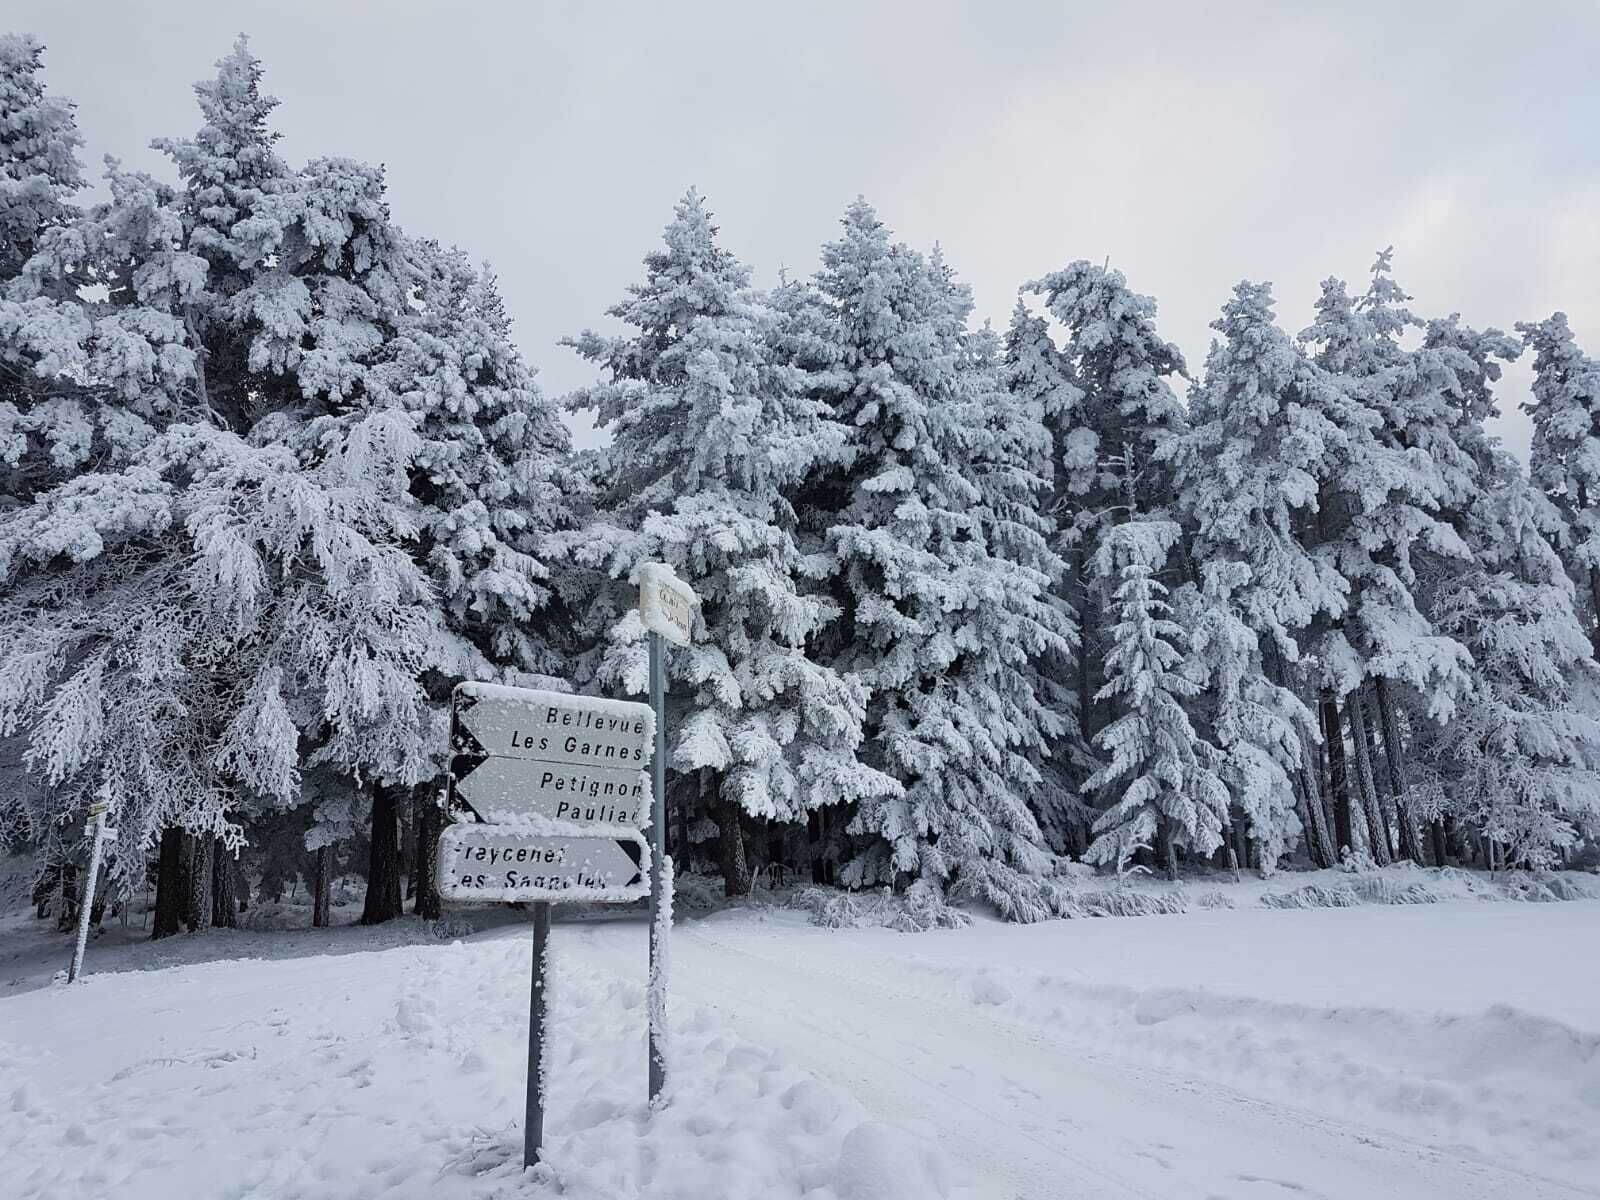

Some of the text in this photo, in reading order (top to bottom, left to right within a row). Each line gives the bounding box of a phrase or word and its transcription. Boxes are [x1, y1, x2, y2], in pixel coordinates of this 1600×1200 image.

[546, 707, 643, 734] Bellevue
[511, 730, 642, 761] Les Garnes
[540, 772, 641, 797] Petignon
[453, 842, 567, 865] raycene
[451, 869, 485, 888] es
